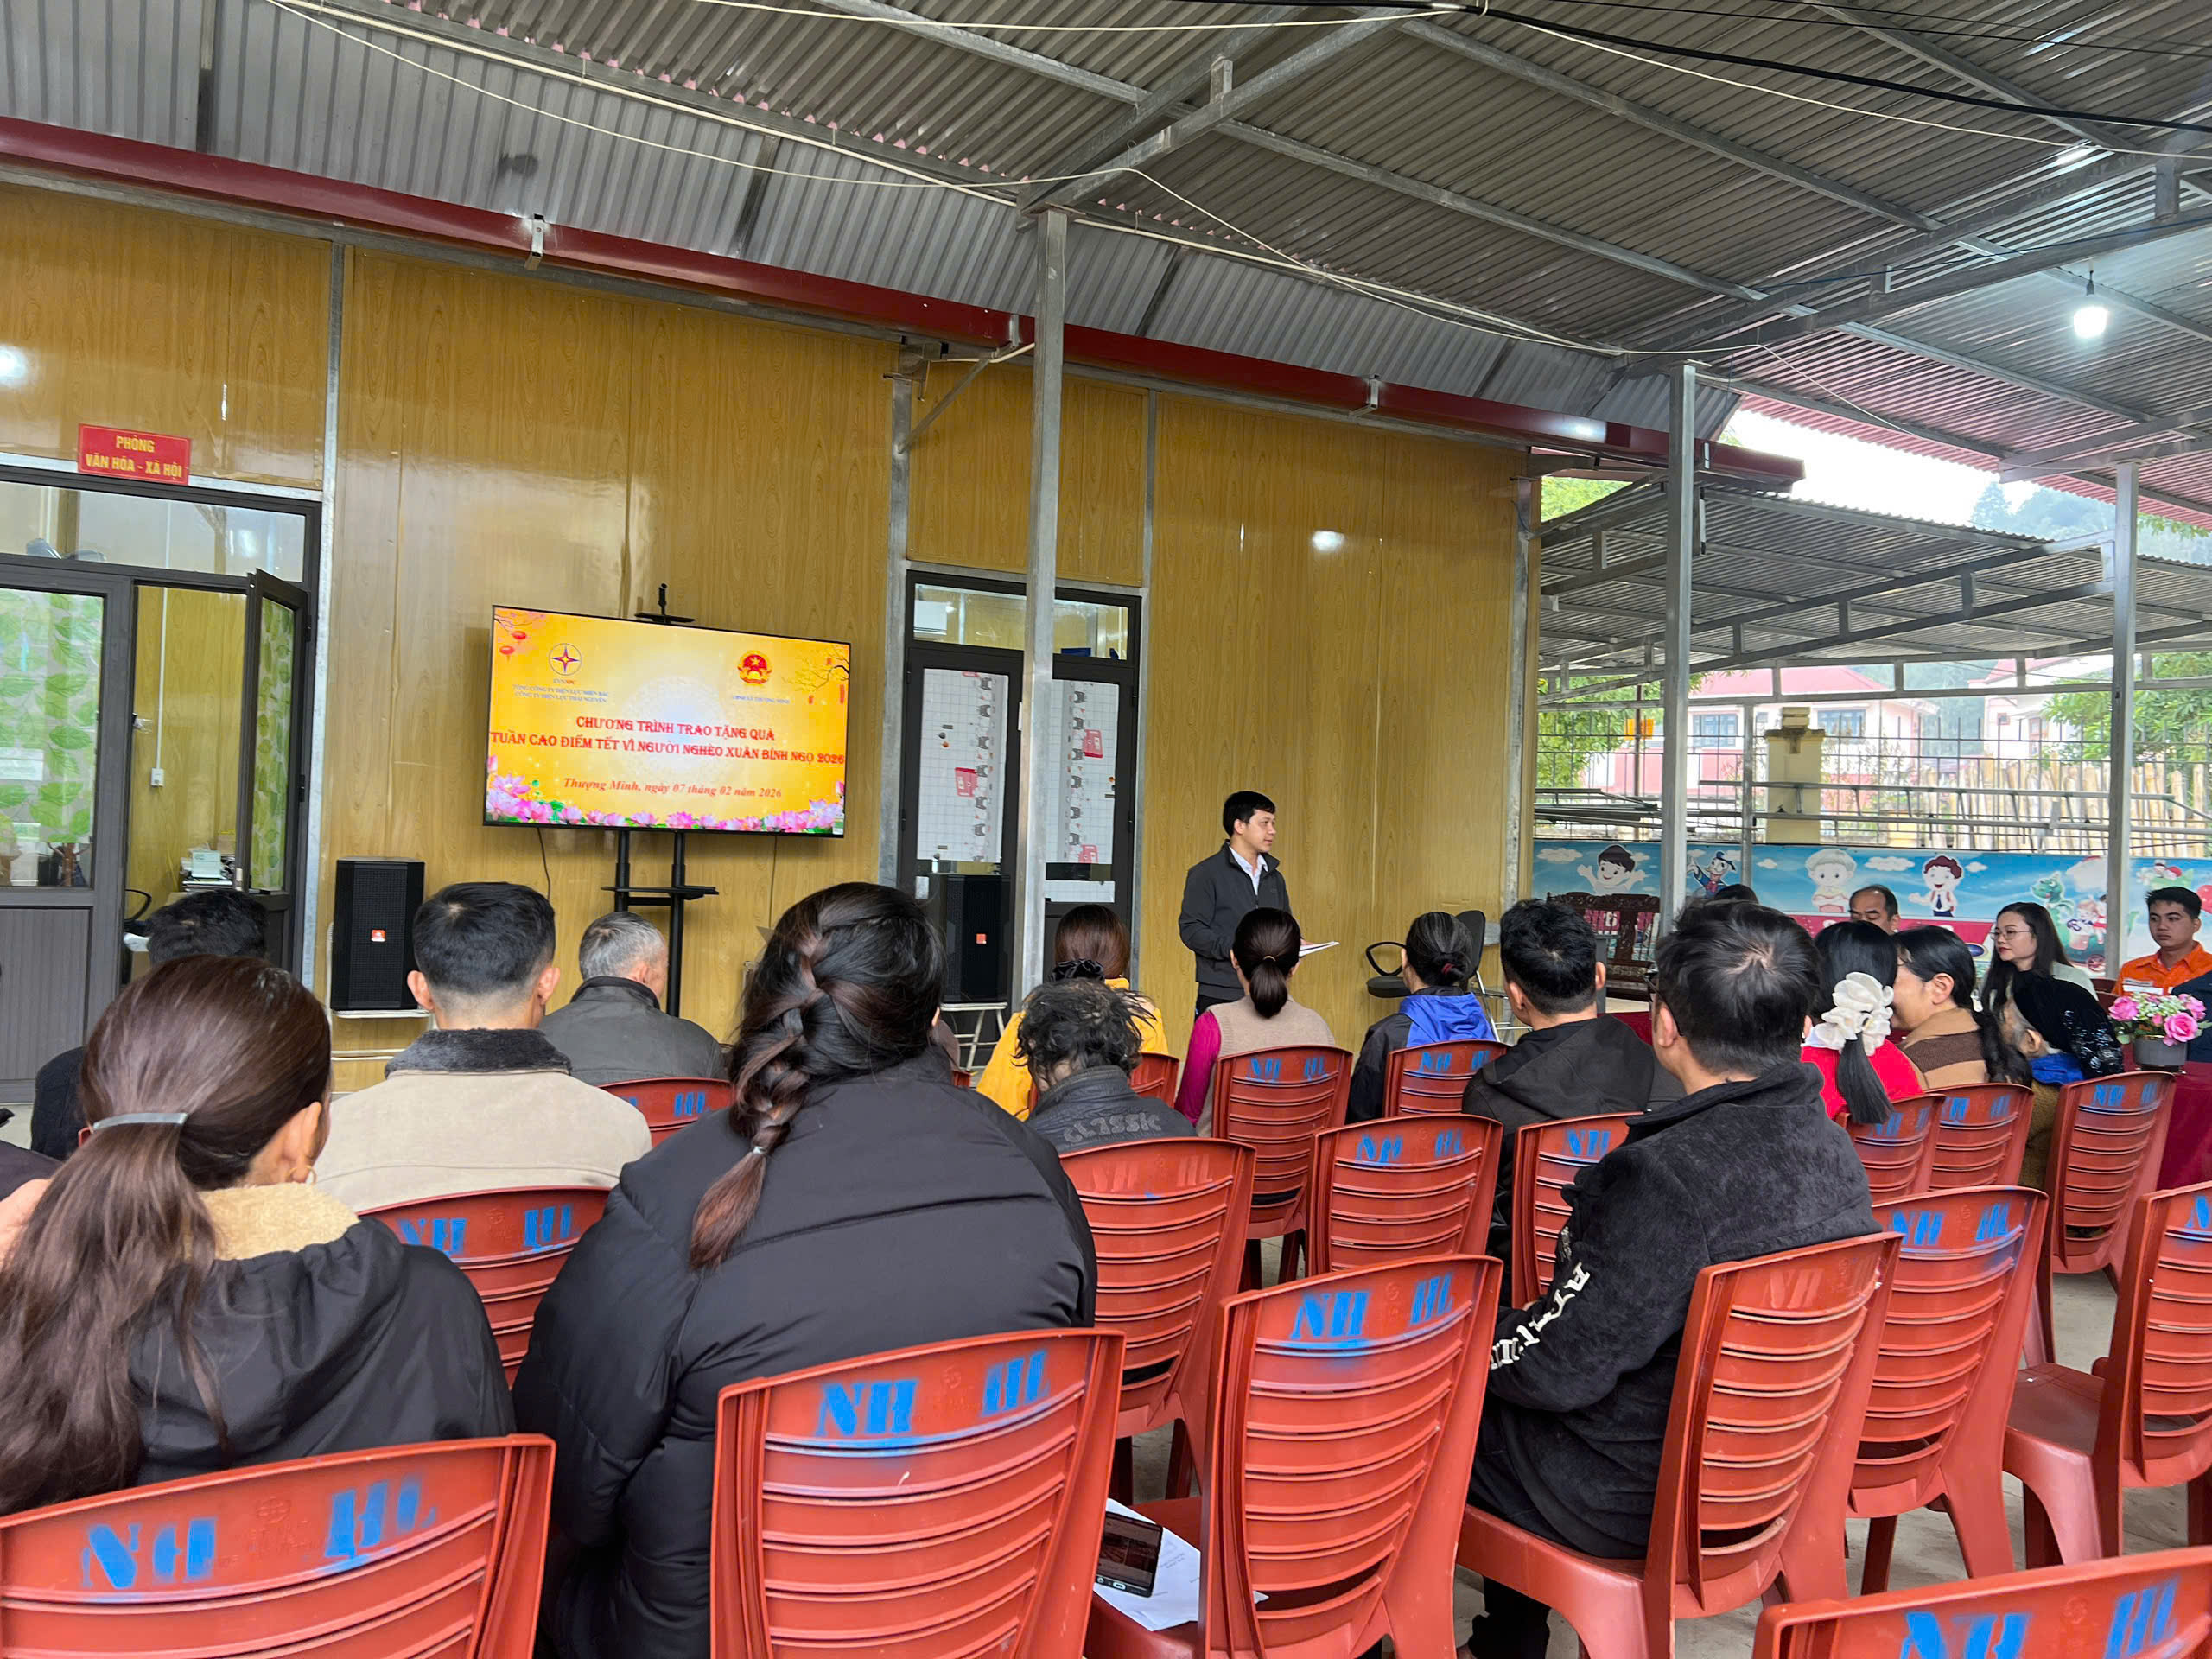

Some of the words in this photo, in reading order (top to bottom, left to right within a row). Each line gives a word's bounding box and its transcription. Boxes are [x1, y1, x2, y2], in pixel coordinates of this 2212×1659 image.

[116, 435, 155, 453] PHÒNG
[86, 453, 109, 468] VĂN
[111, 456, 135, 472] HÓA
[163, 462, 182, 480] HỘI
[576, 715, 633, 731] CHƯƠNG
[637, 719, 673, 734] TRÌNH
[677, 723, 712, 736] TRAO
[715, 724, 747, 740] TẶNG
[750, 728, 775, 741] QUÀ
[491, 729, 525, 745] TUẦN
[529, 734, 557, 747] CAO
[561, 734, 592, 748] ĐIỂM
[595, 736, 619, 750] TẾT
[623, 738, 635, 751] VÌ
[638, 741, 679, 754] NGƯỜI
[683, 743, 723, 757] NGHÈO
[725, 746, 759, 760] XUÂN
[791, 751, 814, 766] NGỌ
[817, 753, 844, 764] 2026
[563, 778, 606, 791] Thượng
[609, 779, 641, 791] Minh,
[645, 783, 669, 795] ngày
[672, 784, 685, 793] 07
[688, 784, 716, 797] tháng
[720, 786, 731, 796] 02
[734, 787, 755, 797] năm
[759, 787, 782, 798] 2026
